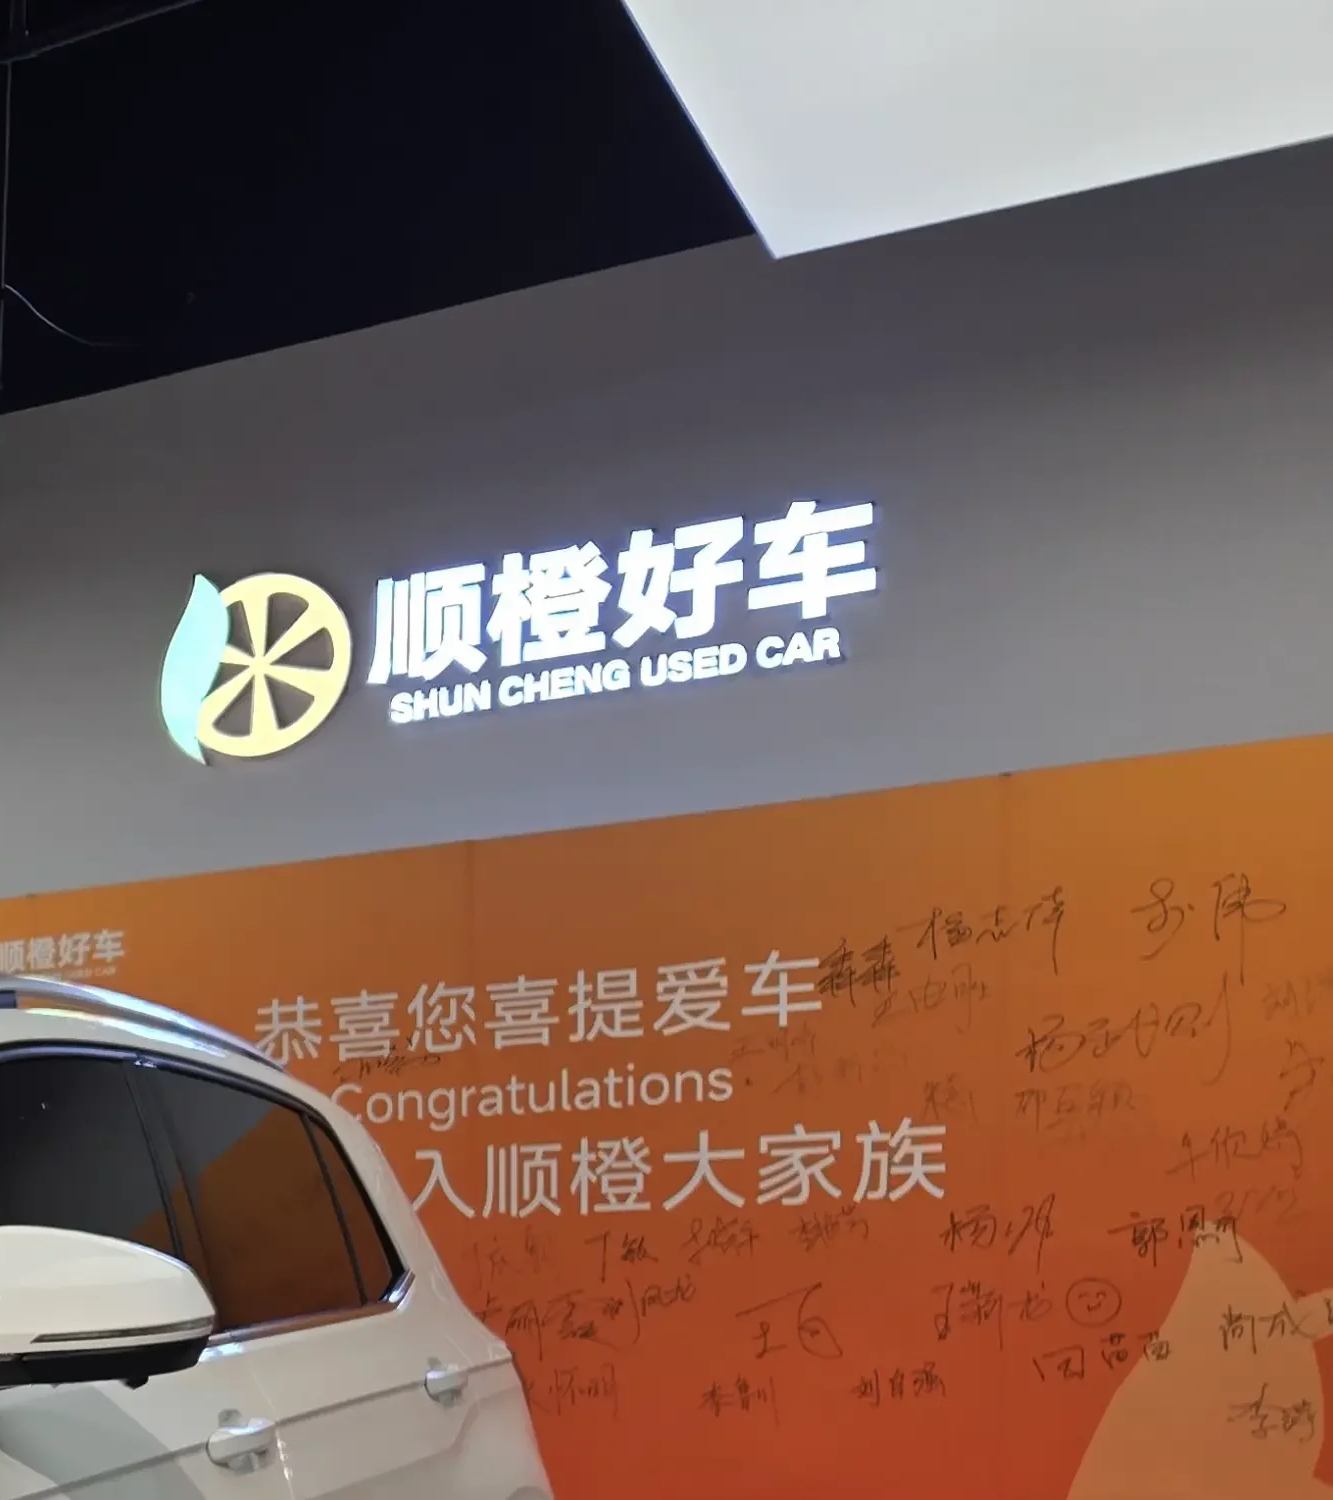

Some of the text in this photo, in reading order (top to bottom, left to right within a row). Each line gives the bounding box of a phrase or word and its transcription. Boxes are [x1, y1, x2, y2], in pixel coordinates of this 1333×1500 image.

[366, 499, 878, 685] 顺橙好车
[389, 627, 842, 724] SHUN CHENG USED CAR
[252, 950, 822, 1066] 恭喜您喜提爱车
[331, 1063, 734, 1132] Congratulations
[414, 1116, 946, 1219] 入顺橙大家族
